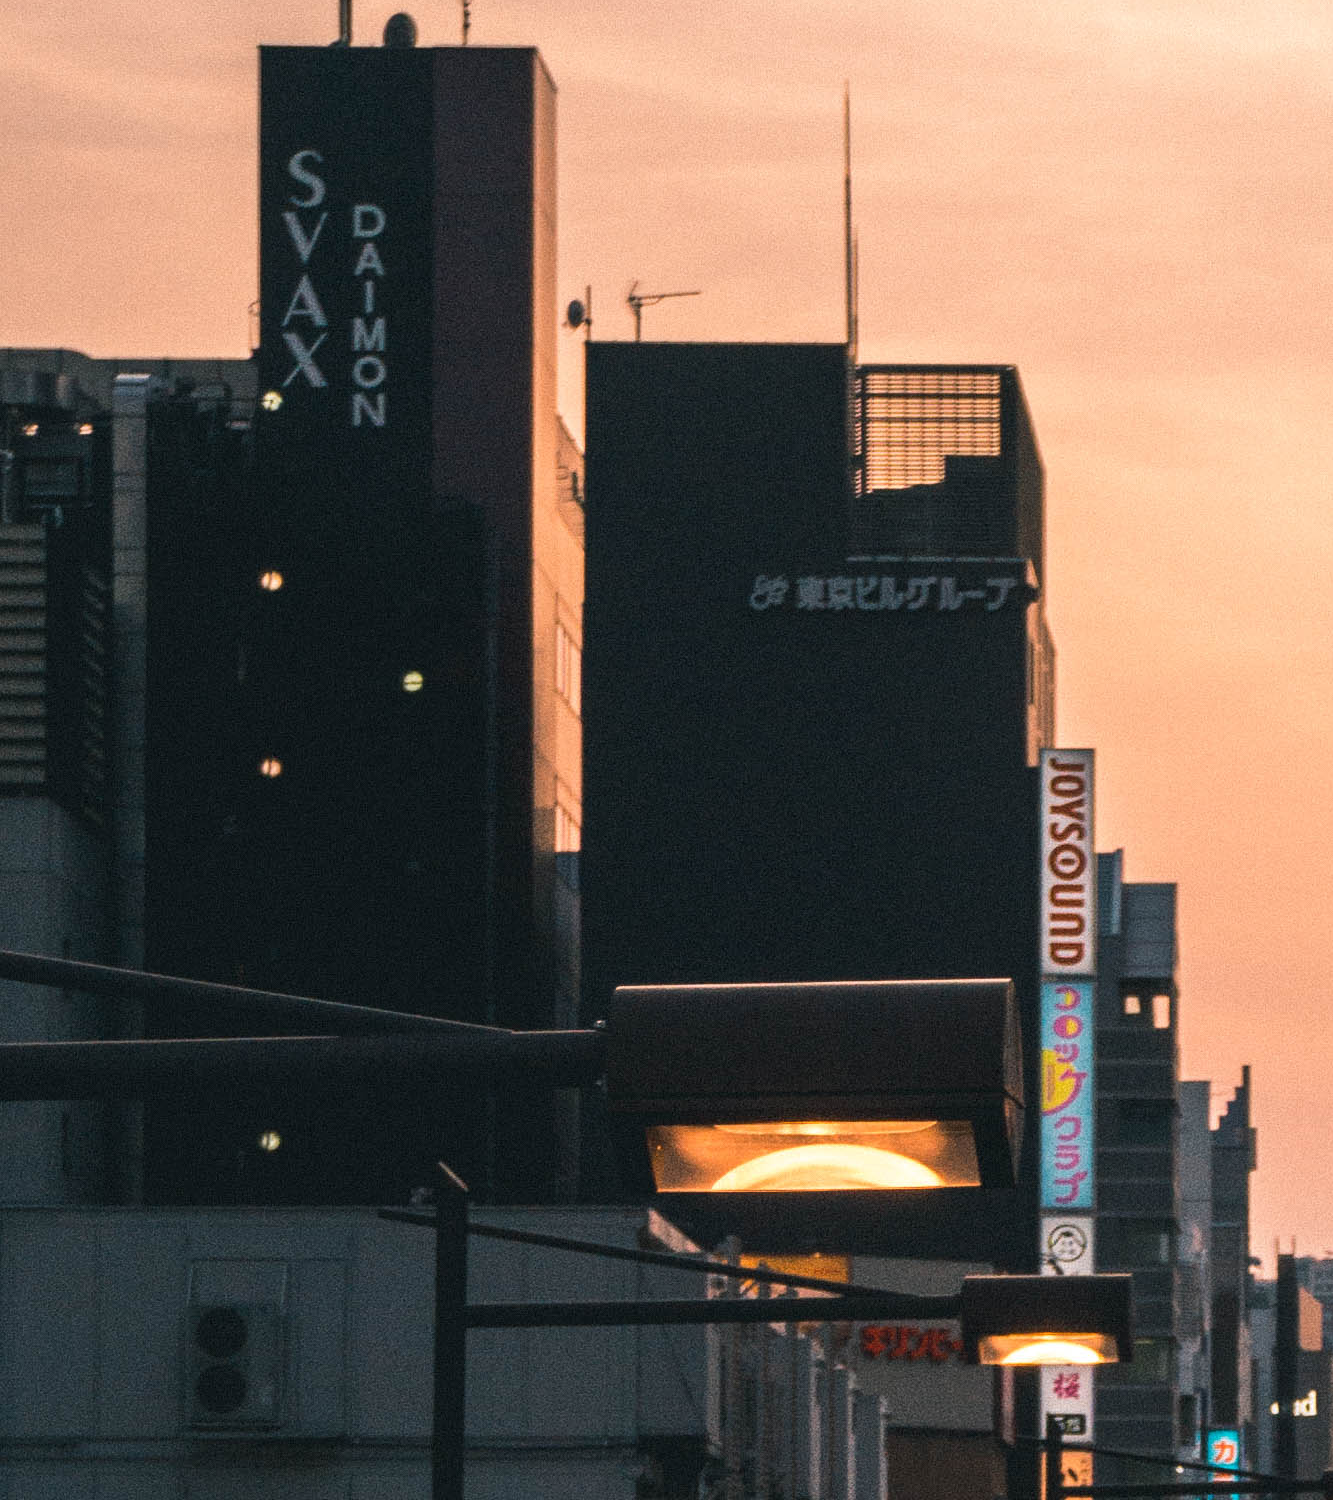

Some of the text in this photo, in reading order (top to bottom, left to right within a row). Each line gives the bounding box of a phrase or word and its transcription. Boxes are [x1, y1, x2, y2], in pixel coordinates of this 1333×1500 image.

[285, 148, 330, 389] SVAX
[351, 203, 387, 428] DAIMON
[1048, 758, 1087, 969] JOYSOUND
